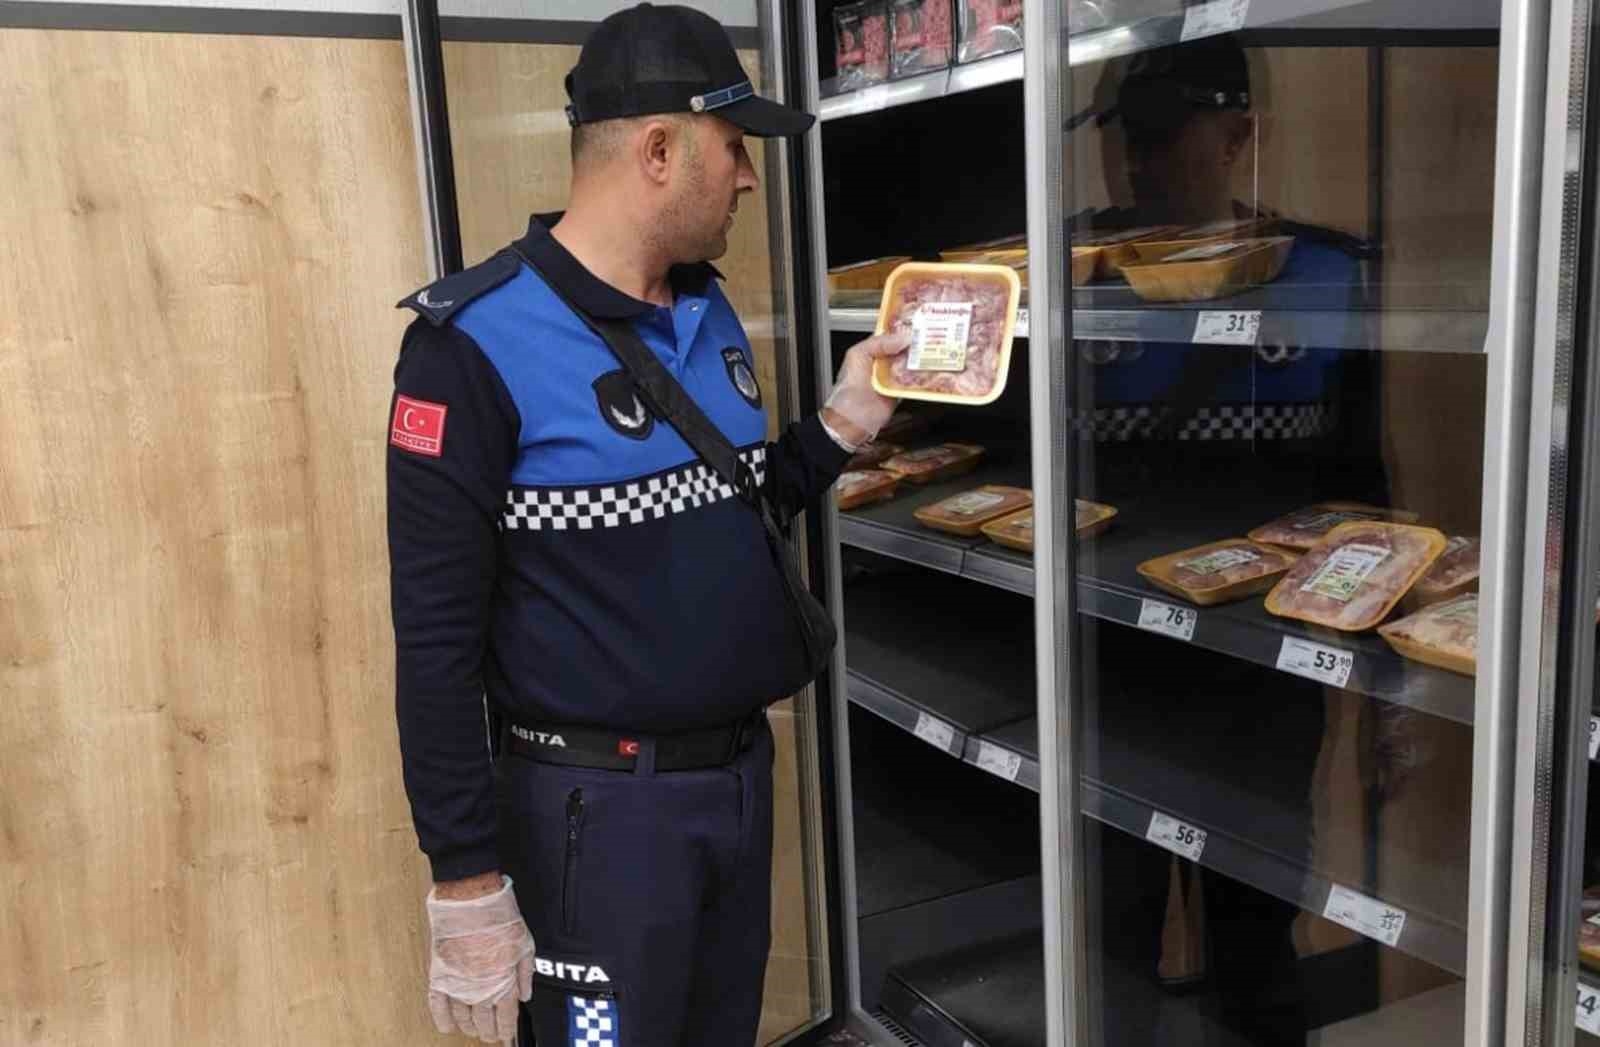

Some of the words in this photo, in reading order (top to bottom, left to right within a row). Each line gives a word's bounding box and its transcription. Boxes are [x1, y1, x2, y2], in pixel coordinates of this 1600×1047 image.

[1226, 314, 1246, 331] 31
[1166, 606, 1185, 626] 76
[1314, 650, 1337, 671] 53
[1175, 825, 1195, 845] 56
[535, 957, 611, 983] BITA
